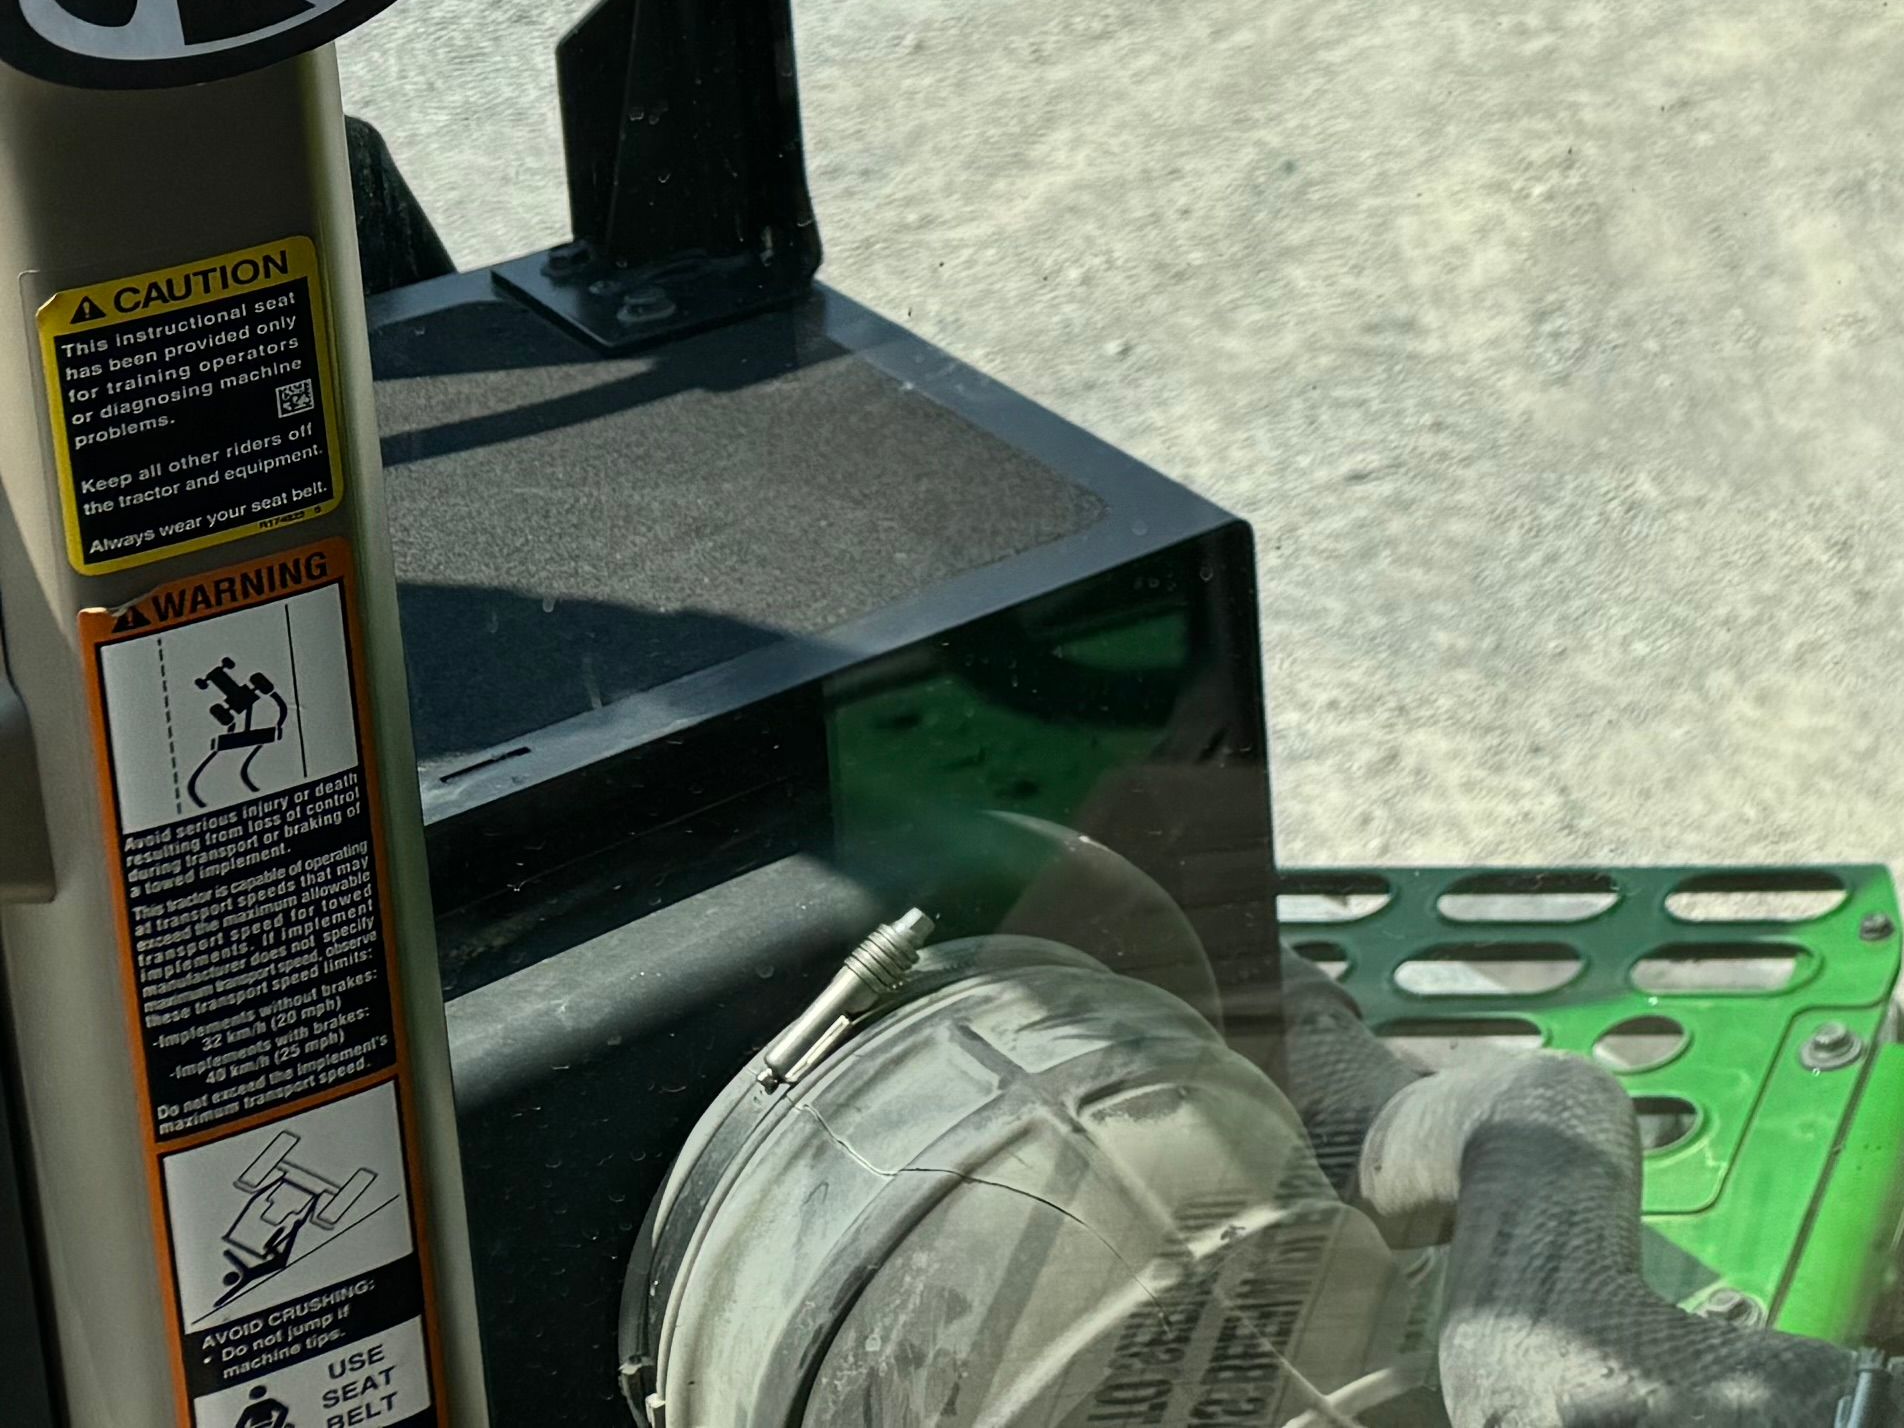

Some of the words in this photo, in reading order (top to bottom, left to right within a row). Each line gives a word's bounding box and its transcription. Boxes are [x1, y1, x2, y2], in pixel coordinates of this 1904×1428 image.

[114, 250, 289, 314] CAUTION
[62, 340, 108, 357] This
[116, 304, 246, 346] instructional
[255, 292, 294, 312] seat
[66, 364, 102, 380] has
[109, 352, 157, 371] been
[165, 325, 249, 361] provided
[257, 316, 296, 334] only
[68, 388, 98, 402] for
[107, 366, 190, 394] training
[200, 338, 298, 372] operators
[72, 412, 93, 424] or
[100, 383, 212, 418] diagnosing
[220, 360, 301, 389] machine
[75, 416, 174, 450] problems.
[82, 474, 132, 494] Keep
[139, 463, 161, 480] all
[169, 451, 219, 472] other
[227, 435, 281, 458] riders
[288, 422, 311, 440] off
[83, 501, 114, 515] the
[119, 484, 180, 508] tractor
[186, 470, 219, 490] and
[224, 444, 322, 480] equipment.
[90, 530, 155, 554] Always
[159, 517, 202, 536] wear
[207, 505, 246, 526] your
[252, 493, 287, 512] seat
[292, 482, 326, 501] belt.
[152, 552, 328, 623] WARNING
[124, 828, 171, 852] Avoid
[176, 812, 238, 838] serious
[243, 796, 288, 818] injury
[294, 790, 309, 803] or
[315, 773, 357, 796] death
[126, 838, 200, 867] resulting
[205, 826, 243, 845] from
[248, 814, 281, 832] loss
[286, 806, 300, 821] of
[306, 786, 359, 815] control
[128, 859, 181, 882] during
[186, 835, 258, 867] transport
[263, 831, 279, 844] or
[284, 811, 342, 838] braking
[347, 802, 360, 817] of
[130, 886, 140, 898] a
[145, 868, 194, 894] towed
[200, 843, 291, 878] implement.
[132, 904, 164, 920] This
[289, 860, 302, 876] of
[305, 841, 367, 870] operating
[135, 921, 152, 936] at
[156, 898, 233, 931] transport
[238, 880, 296, 907] speeds
[300, 867, 331, 887] that
[337, 856, 368, 876] may
[138, 932, 224, 967] transport
[230, 913, 283, 940] speed
[290, 906, 314, 921] for
[322, 883, 372, 912] towed
[194, 920, 220, 936] the
[302, 872, 370, 903] allowable
[140, 938, 254, 982] implements.
[263, 931, 274, 946] If
[282, 901, 372, 940] implement
[142, 958, 246, 998] manufacturer
[250, 946, 287, 966] does
[291, 934, 315, 953] not
[323, 916, 374, 942] specify
[145, 1007, 190, 1028] these
[195, 981, 268, 1014] transport
[272, 964, 318, 990] speed
[324, 948, 372, 974] limits:
[215, 963, 276, 992] transport
[259, 988, 317, 1017] without
[321, 970, 376, 996] brakes:
[202, 1034, 222, 1051] 32
[301, 996, 341, 1019] mph)
[274, 1043, 300, 1064] (25
[305, 1028, 344, 1053] mph)
[275, 1026, 308, 1046] with
[313, 1007, 369, 1034] brakes:
[158, 1105, 179, 1120] Do
[184, 1094, 208, 1112] not
[269, 1068, 294, 1084] the
[244, 1075, 316, 1109] transport
[203, 1319, 264, 1350] AVOID
[268, 1278, 375, 1327] CRUSHING:
[222, 1344, 246, 1362] Do
[253, 1330, 282, 1351] not
[287, 1313, 332, 1342] jump
[338, 1304, 350, 1319] if
[223, 1343, 301, 1378] machine
[306, 1329, 345, 1350] tips.
[329, 1345, 385, 1379] USE
[322, 1366, 395, 1408] SEAT
[327, 1393, 397, 1428] BELT
